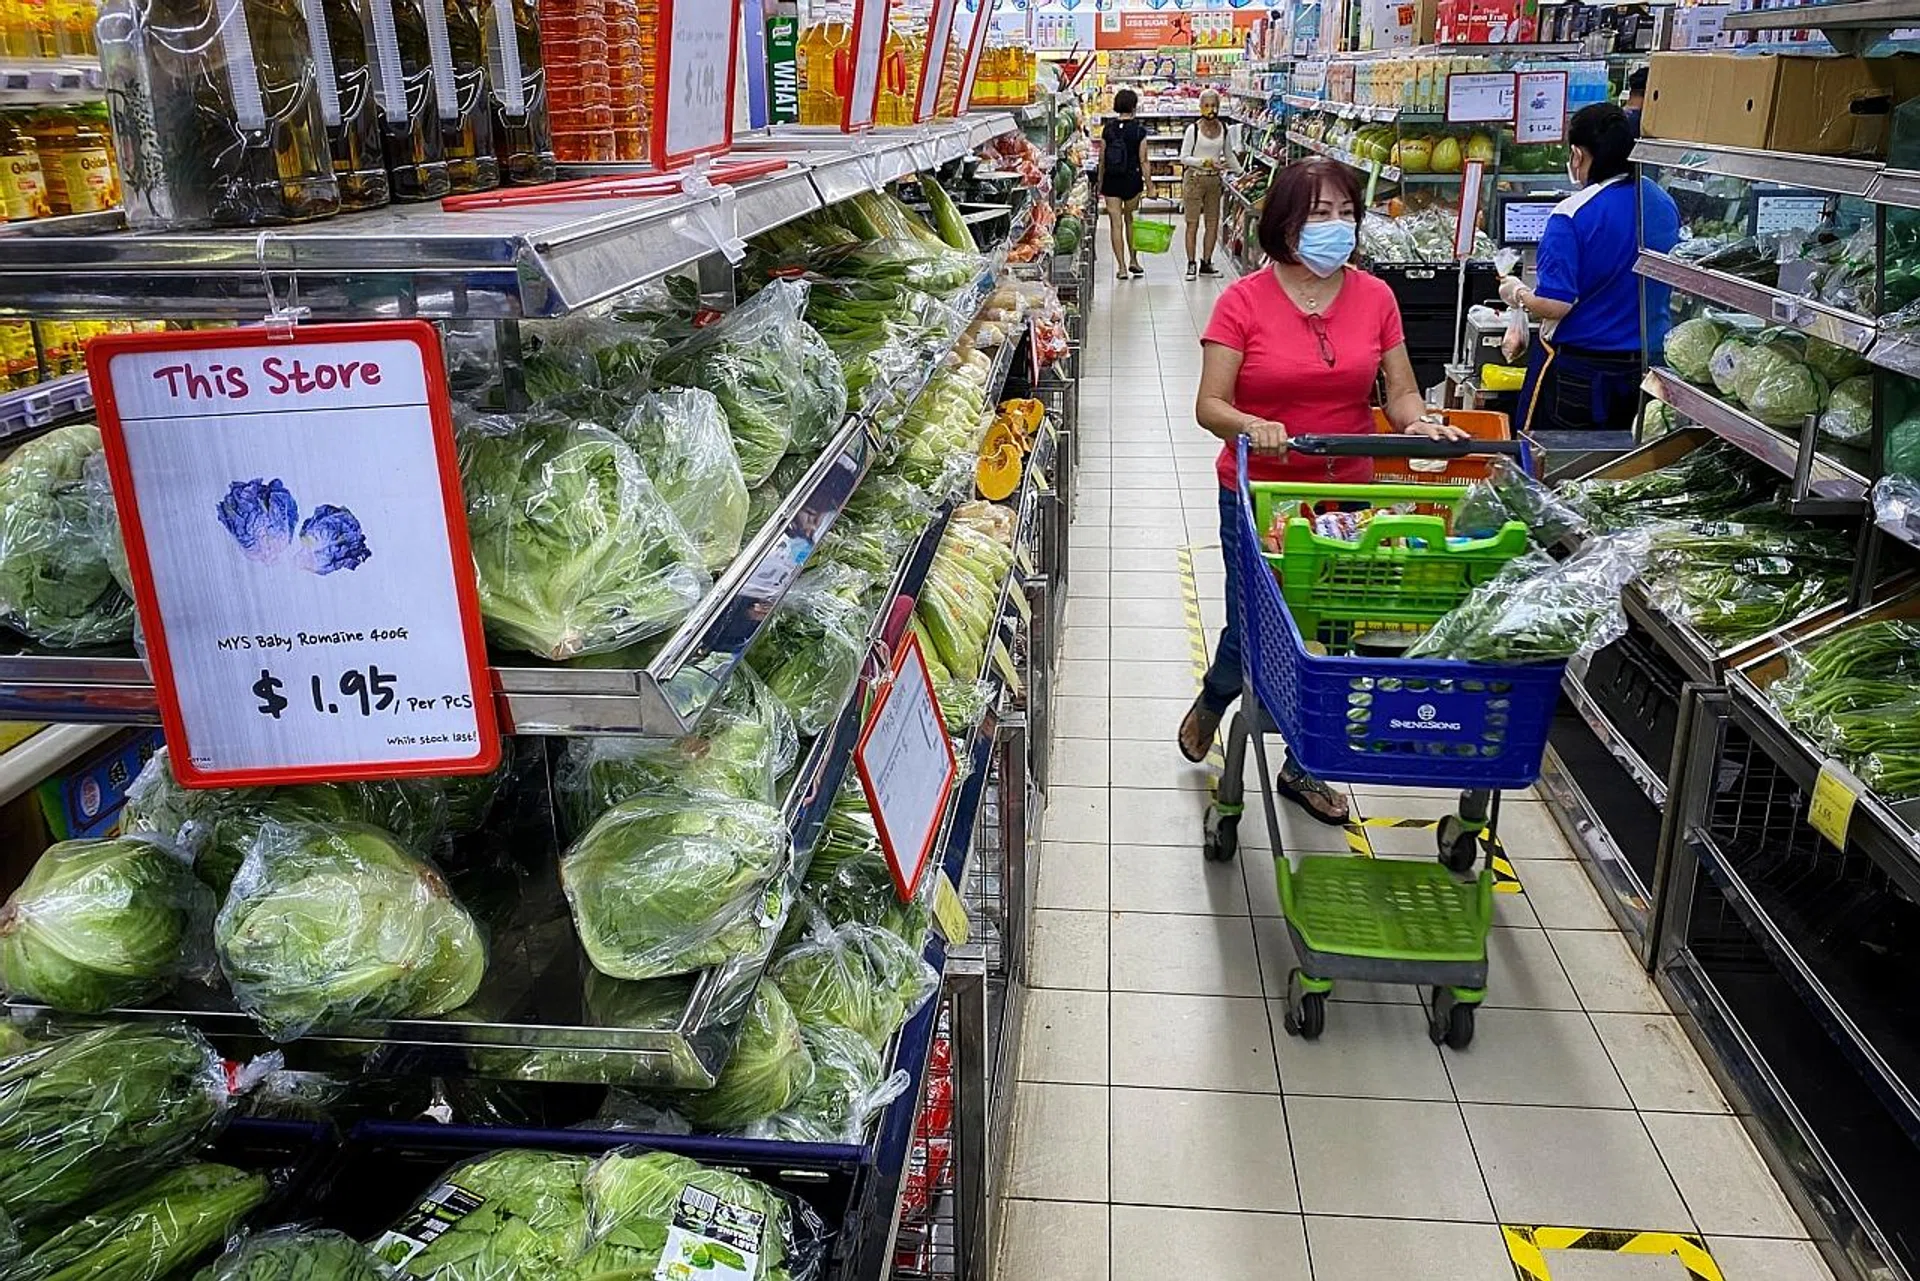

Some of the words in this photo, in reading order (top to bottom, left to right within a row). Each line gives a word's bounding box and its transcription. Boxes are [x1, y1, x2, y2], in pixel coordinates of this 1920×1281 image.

[1125, 19, 1143, 27] LESS
[1144, 18, 1169, 27] SUGAR
[774, 60, 798, 115] WHAT
[153, 363, 249, 400] This
[263, 357, 381, 394] Store
[217, 637, 251, 651] MYS
[256, 633, 293, 652] Baby
[297, 631, 364, 646] Romaine
[370, 627, 408, 641] 400G
[252, 669, 288, 719] $
[419, 734, 449, 745] stock
[731, 1238, 757, 1253] BABY
